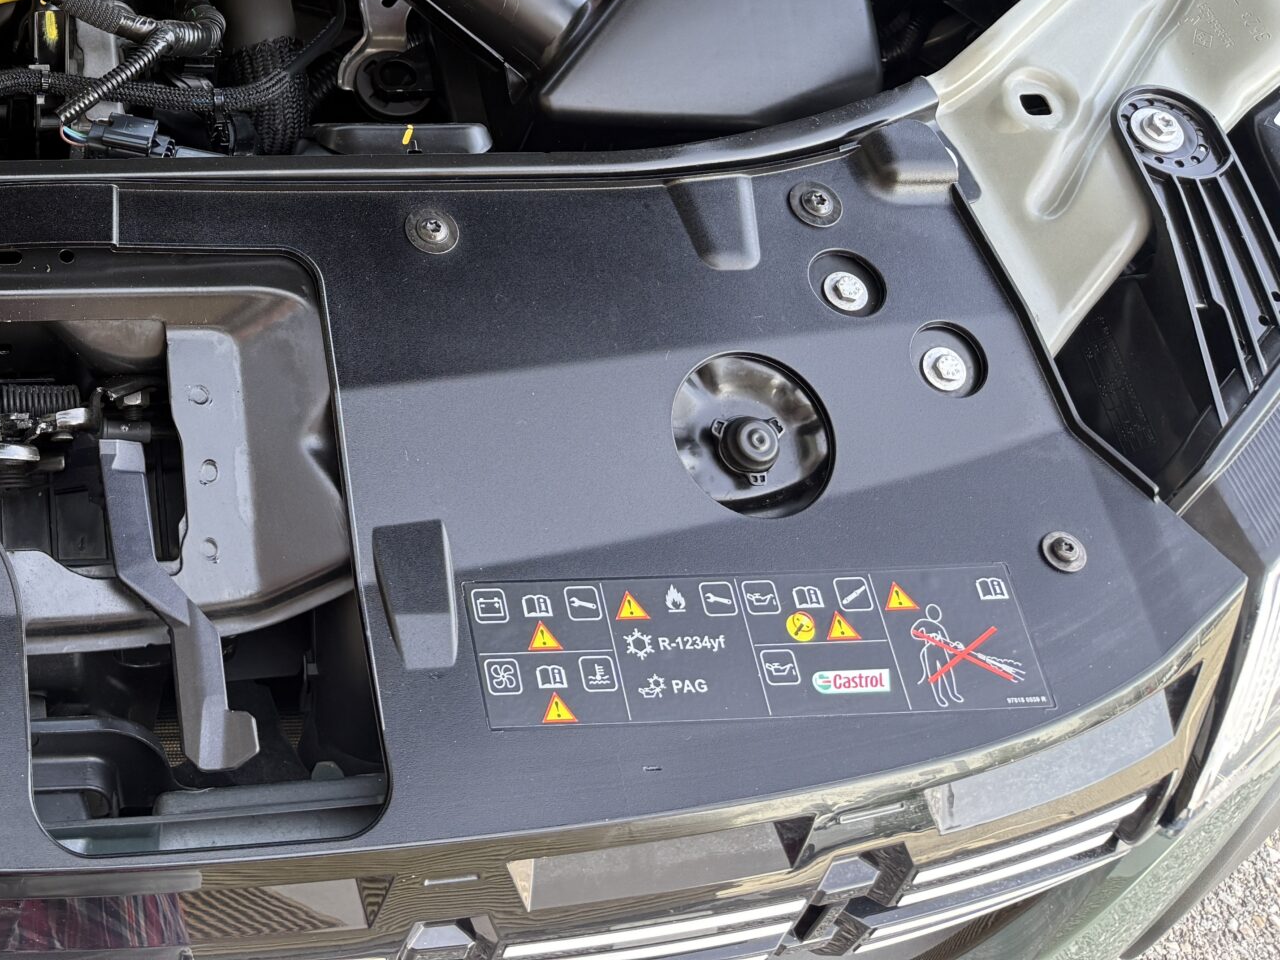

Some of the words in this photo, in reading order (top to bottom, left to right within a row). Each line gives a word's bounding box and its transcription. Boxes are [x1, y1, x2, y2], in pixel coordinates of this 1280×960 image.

[658, 635, 726, 652] R-1234yf
[671, 679, 709, 693] PAG
[833, 672, 885, 689] Castrol
